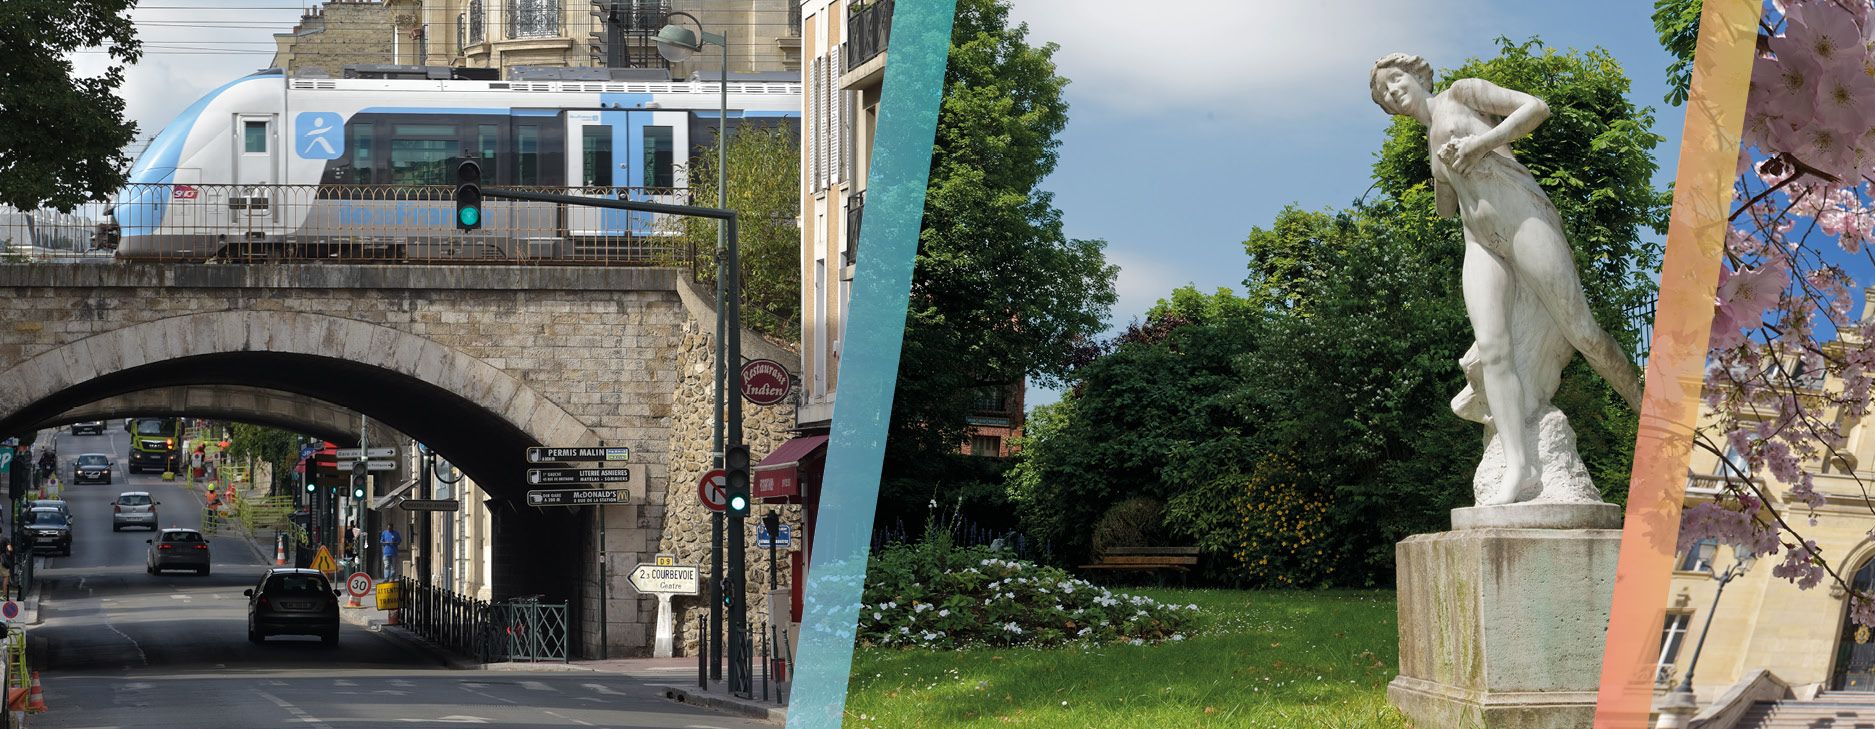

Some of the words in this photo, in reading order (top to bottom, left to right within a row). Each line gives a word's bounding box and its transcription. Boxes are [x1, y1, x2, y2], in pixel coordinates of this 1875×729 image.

[743, 363, 786, 385] Restaurant
[746, 383, 783, 395] Indien
[548, 449, 577, 457] PERMIS
[652, 569, 694, 580] COURBEVOIE
[352, 579, 367, 591] 30
[660, 581, 681, 590] Centre
